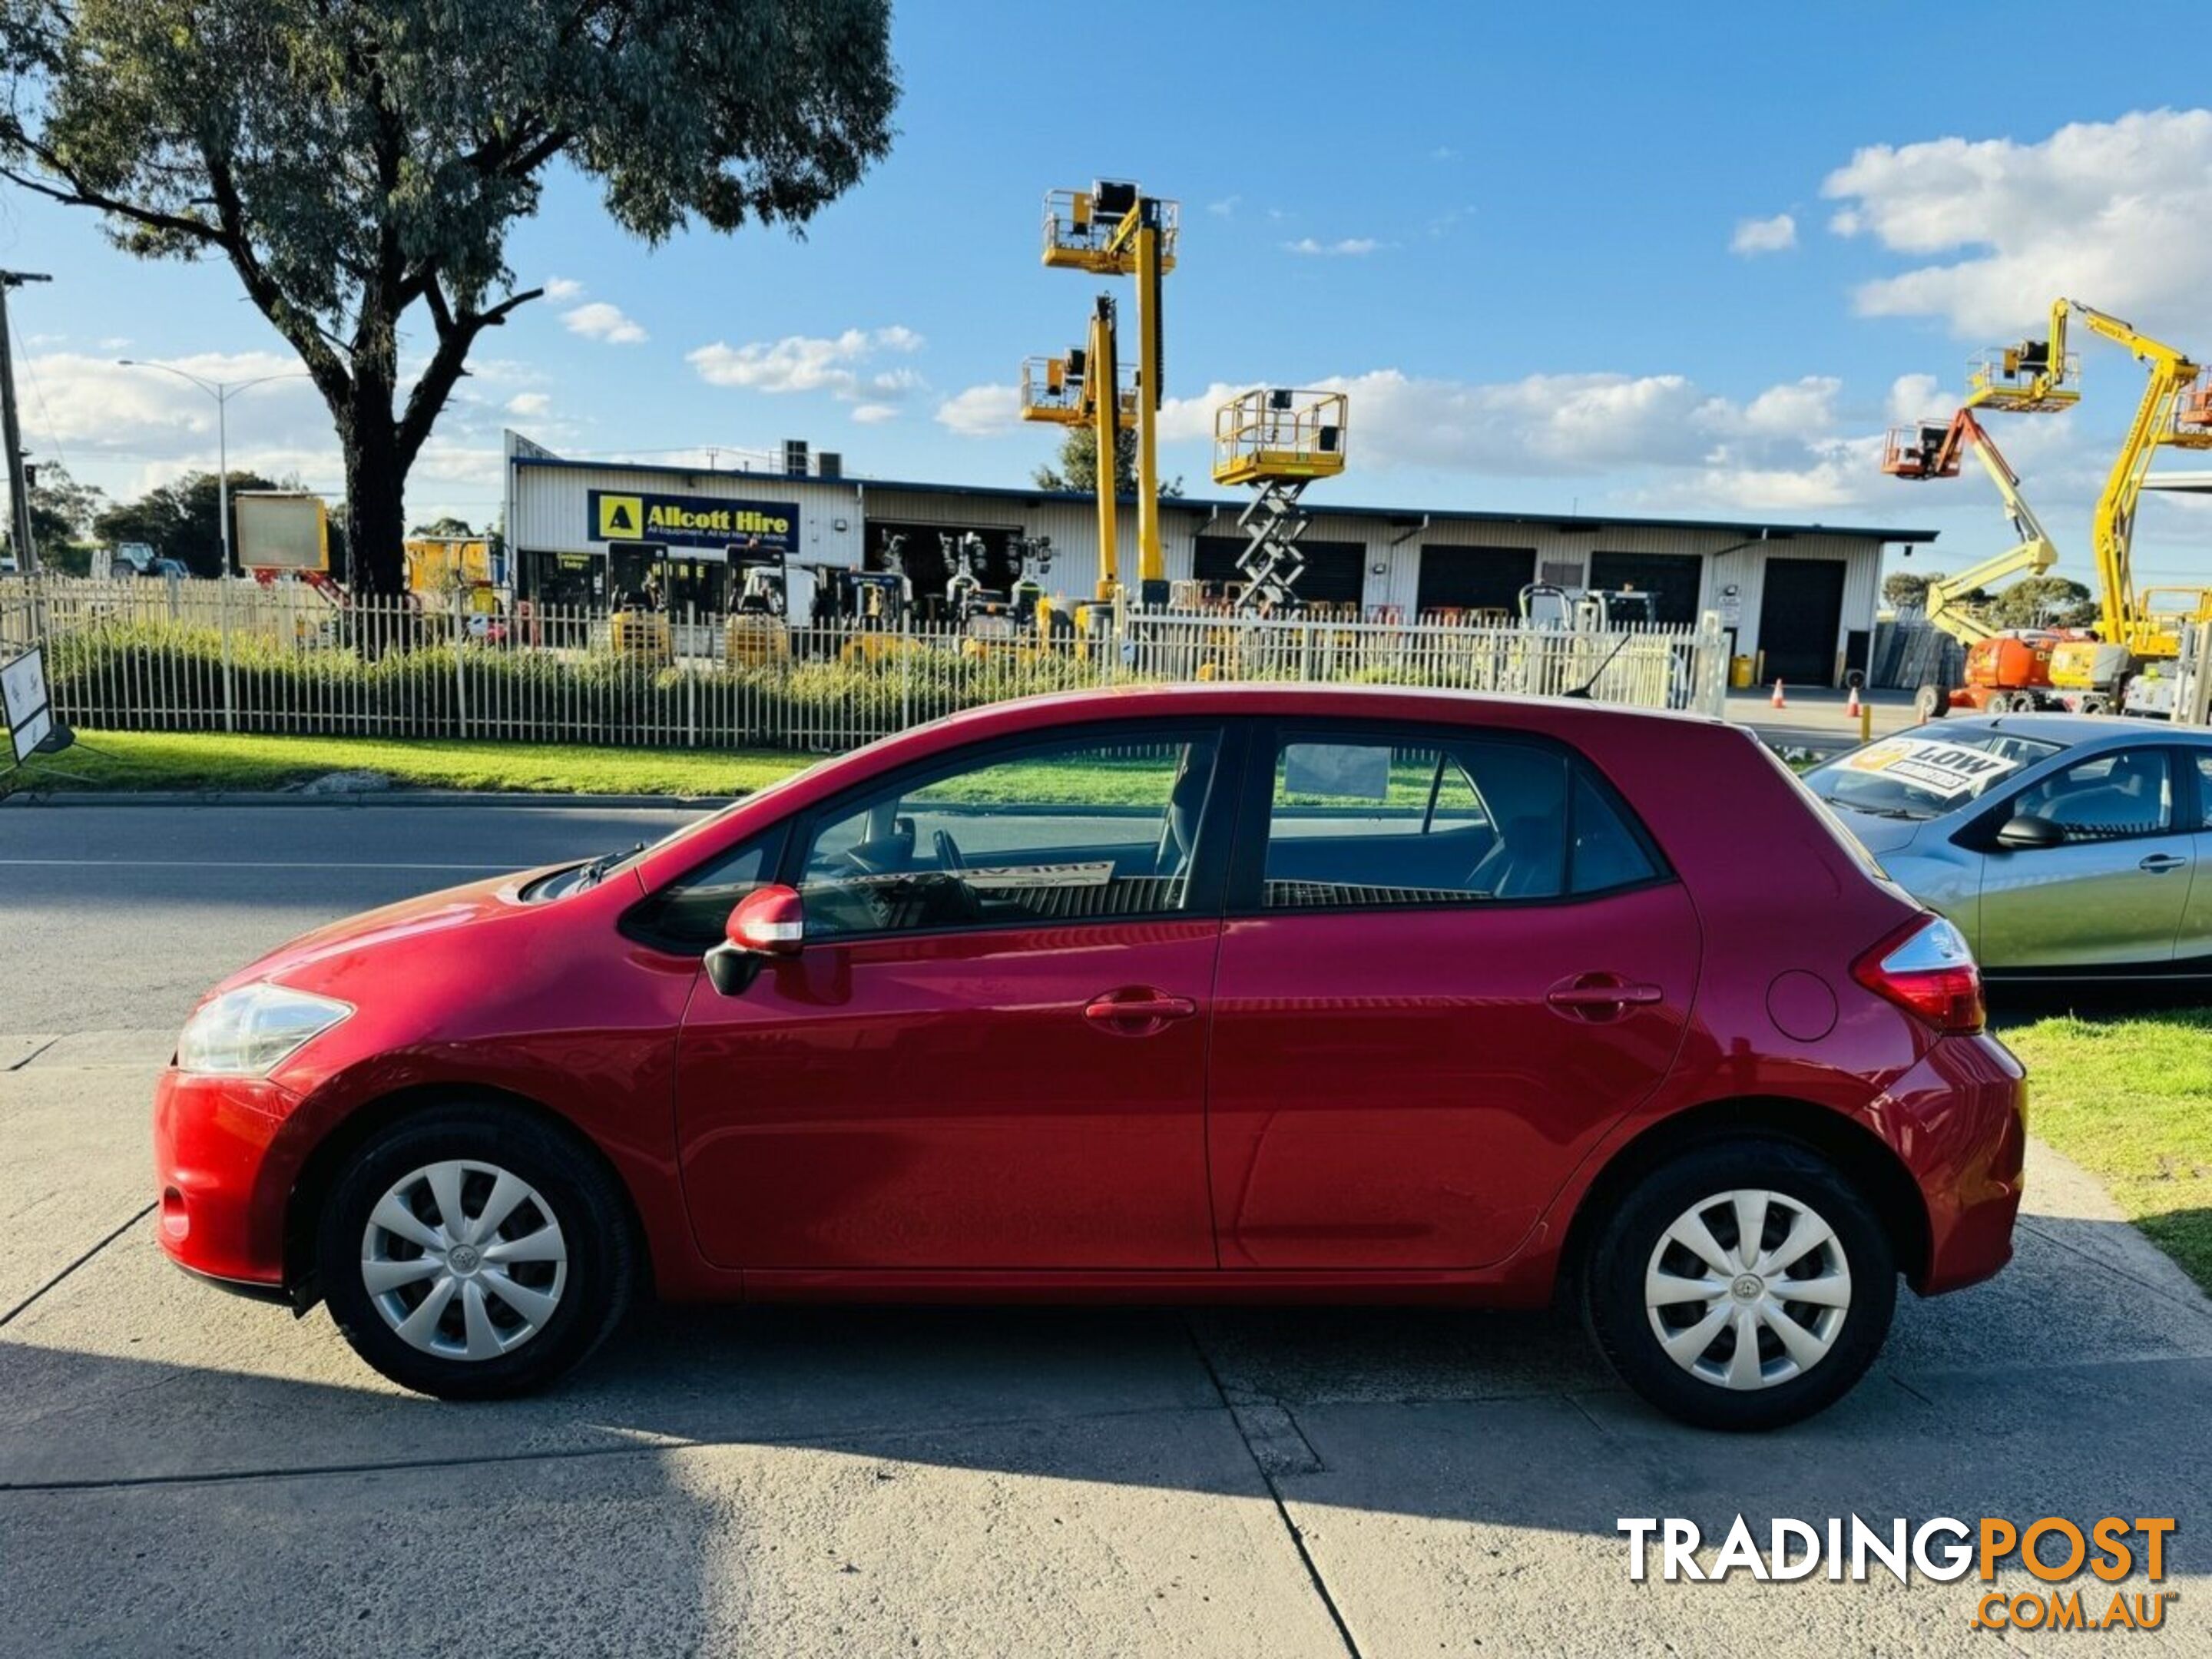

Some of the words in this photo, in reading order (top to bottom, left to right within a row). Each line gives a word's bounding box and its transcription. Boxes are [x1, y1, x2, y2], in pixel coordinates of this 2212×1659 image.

[647, 505, 731, 530] Allcott
[736, 511, 789, 534] Hire
[1911, 745, 2002, 774] LOW
